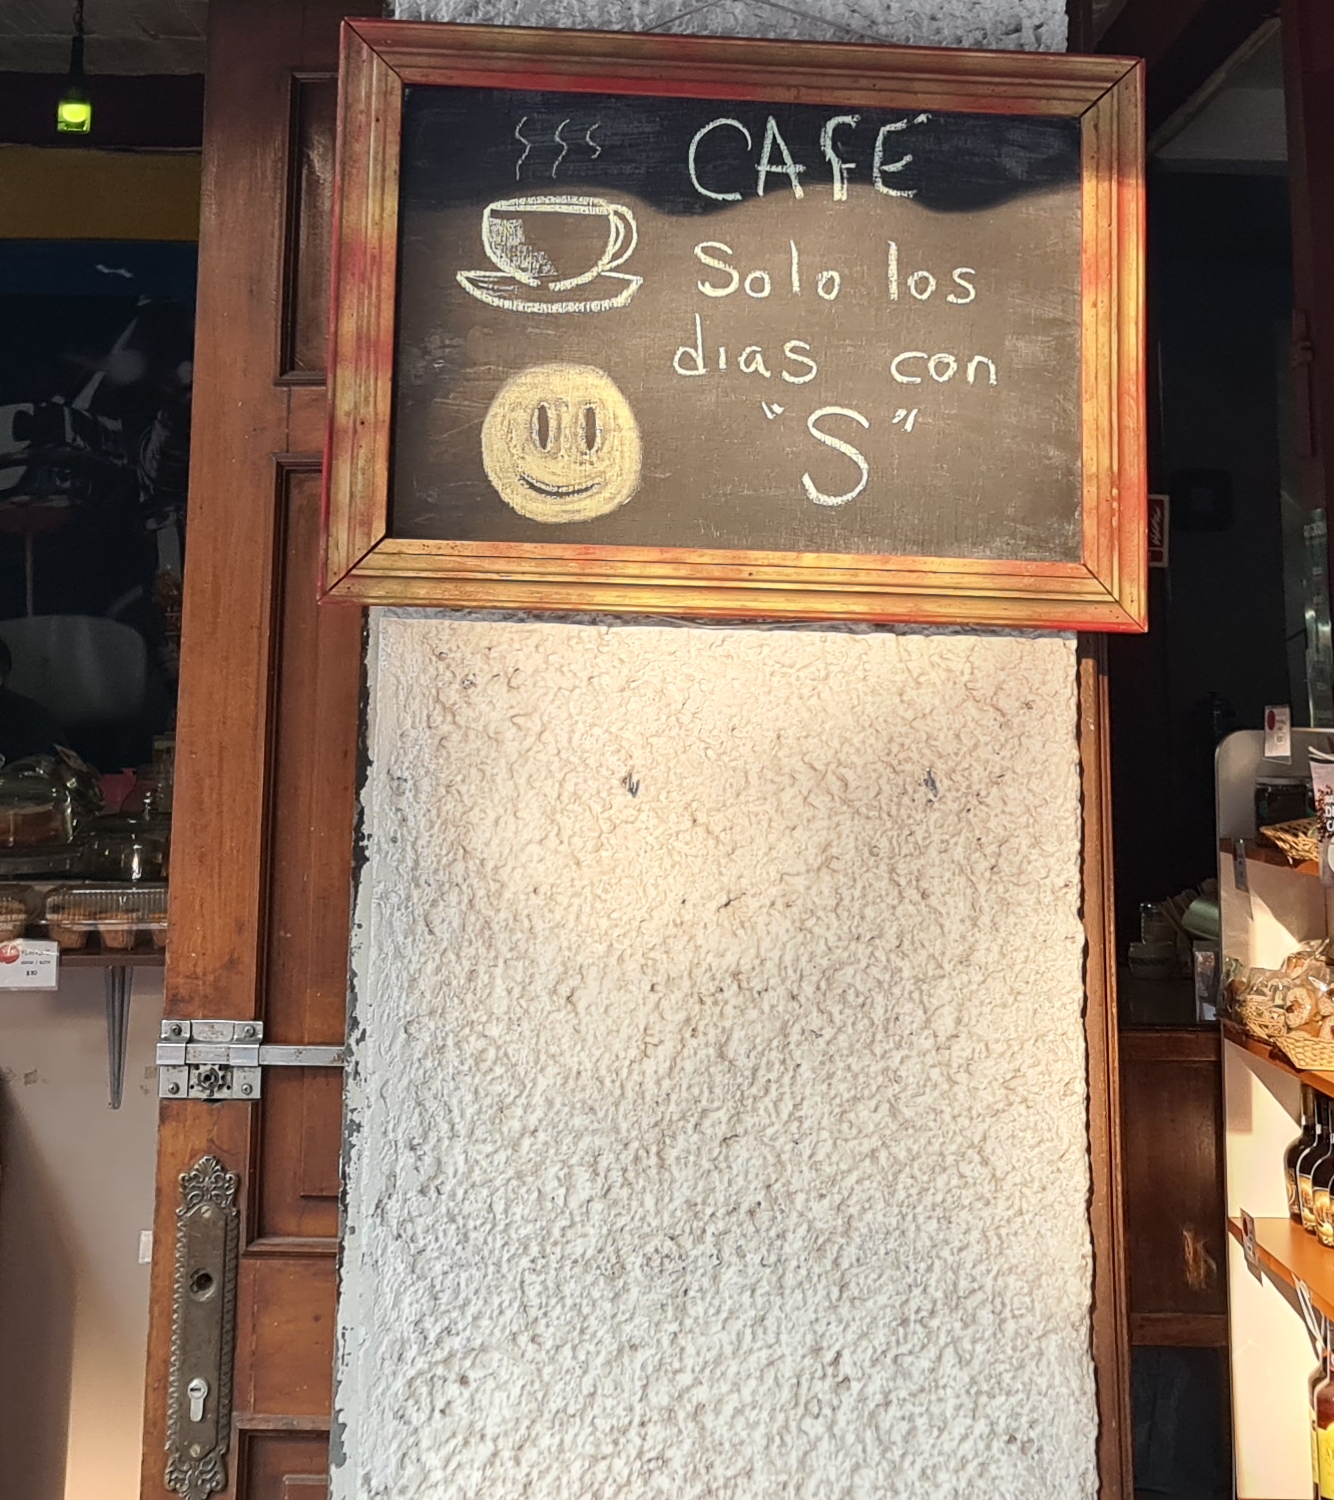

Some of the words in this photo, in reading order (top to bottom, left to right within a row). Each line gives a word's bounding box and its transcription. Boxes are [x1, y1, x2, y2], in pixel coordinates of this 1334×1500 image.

[693, 239, 844, 301] Solo
[887, 239, 979, 305] los
[673, 311, 820, 387] dias
[890, 348, 999, 388] con
